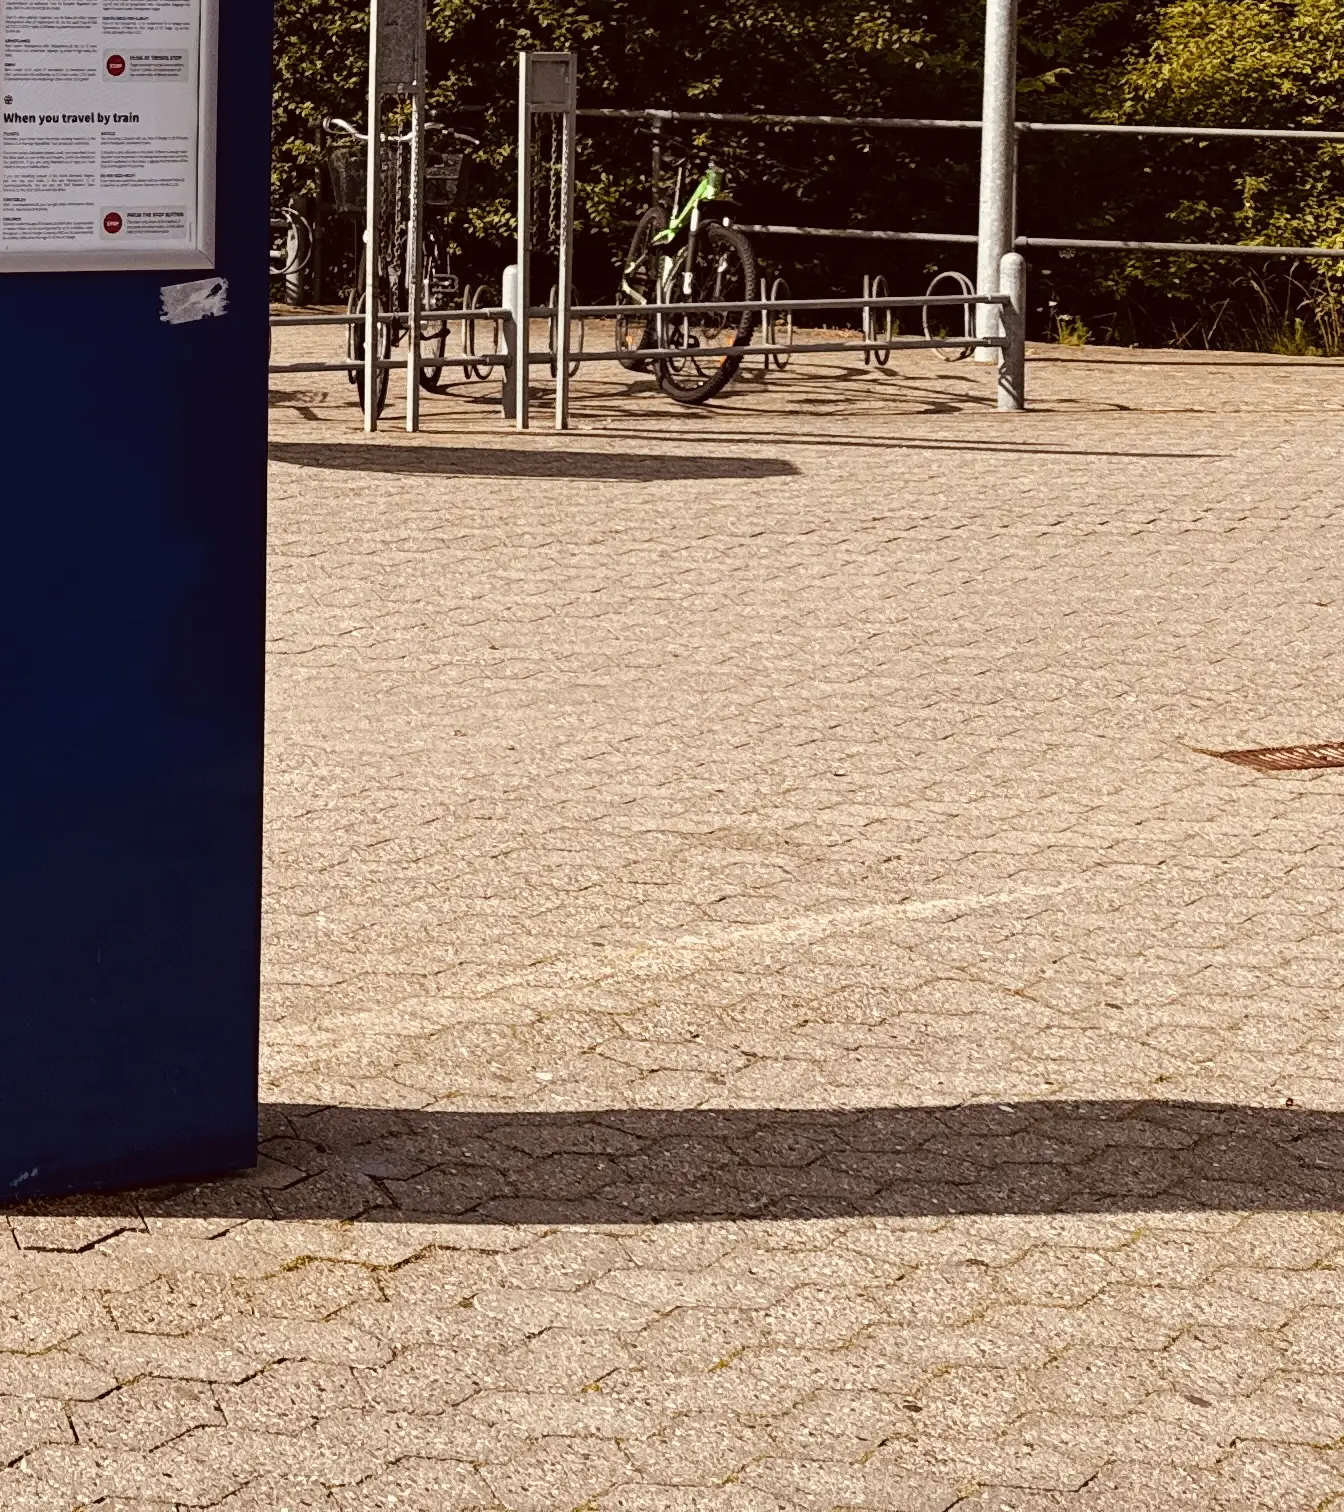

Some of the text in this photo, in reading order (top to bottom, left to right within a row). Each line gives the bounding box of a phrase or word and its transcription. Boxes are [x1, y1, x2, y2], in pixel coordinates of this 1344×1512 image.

[3, 112, 140, 126] When you travel by train
